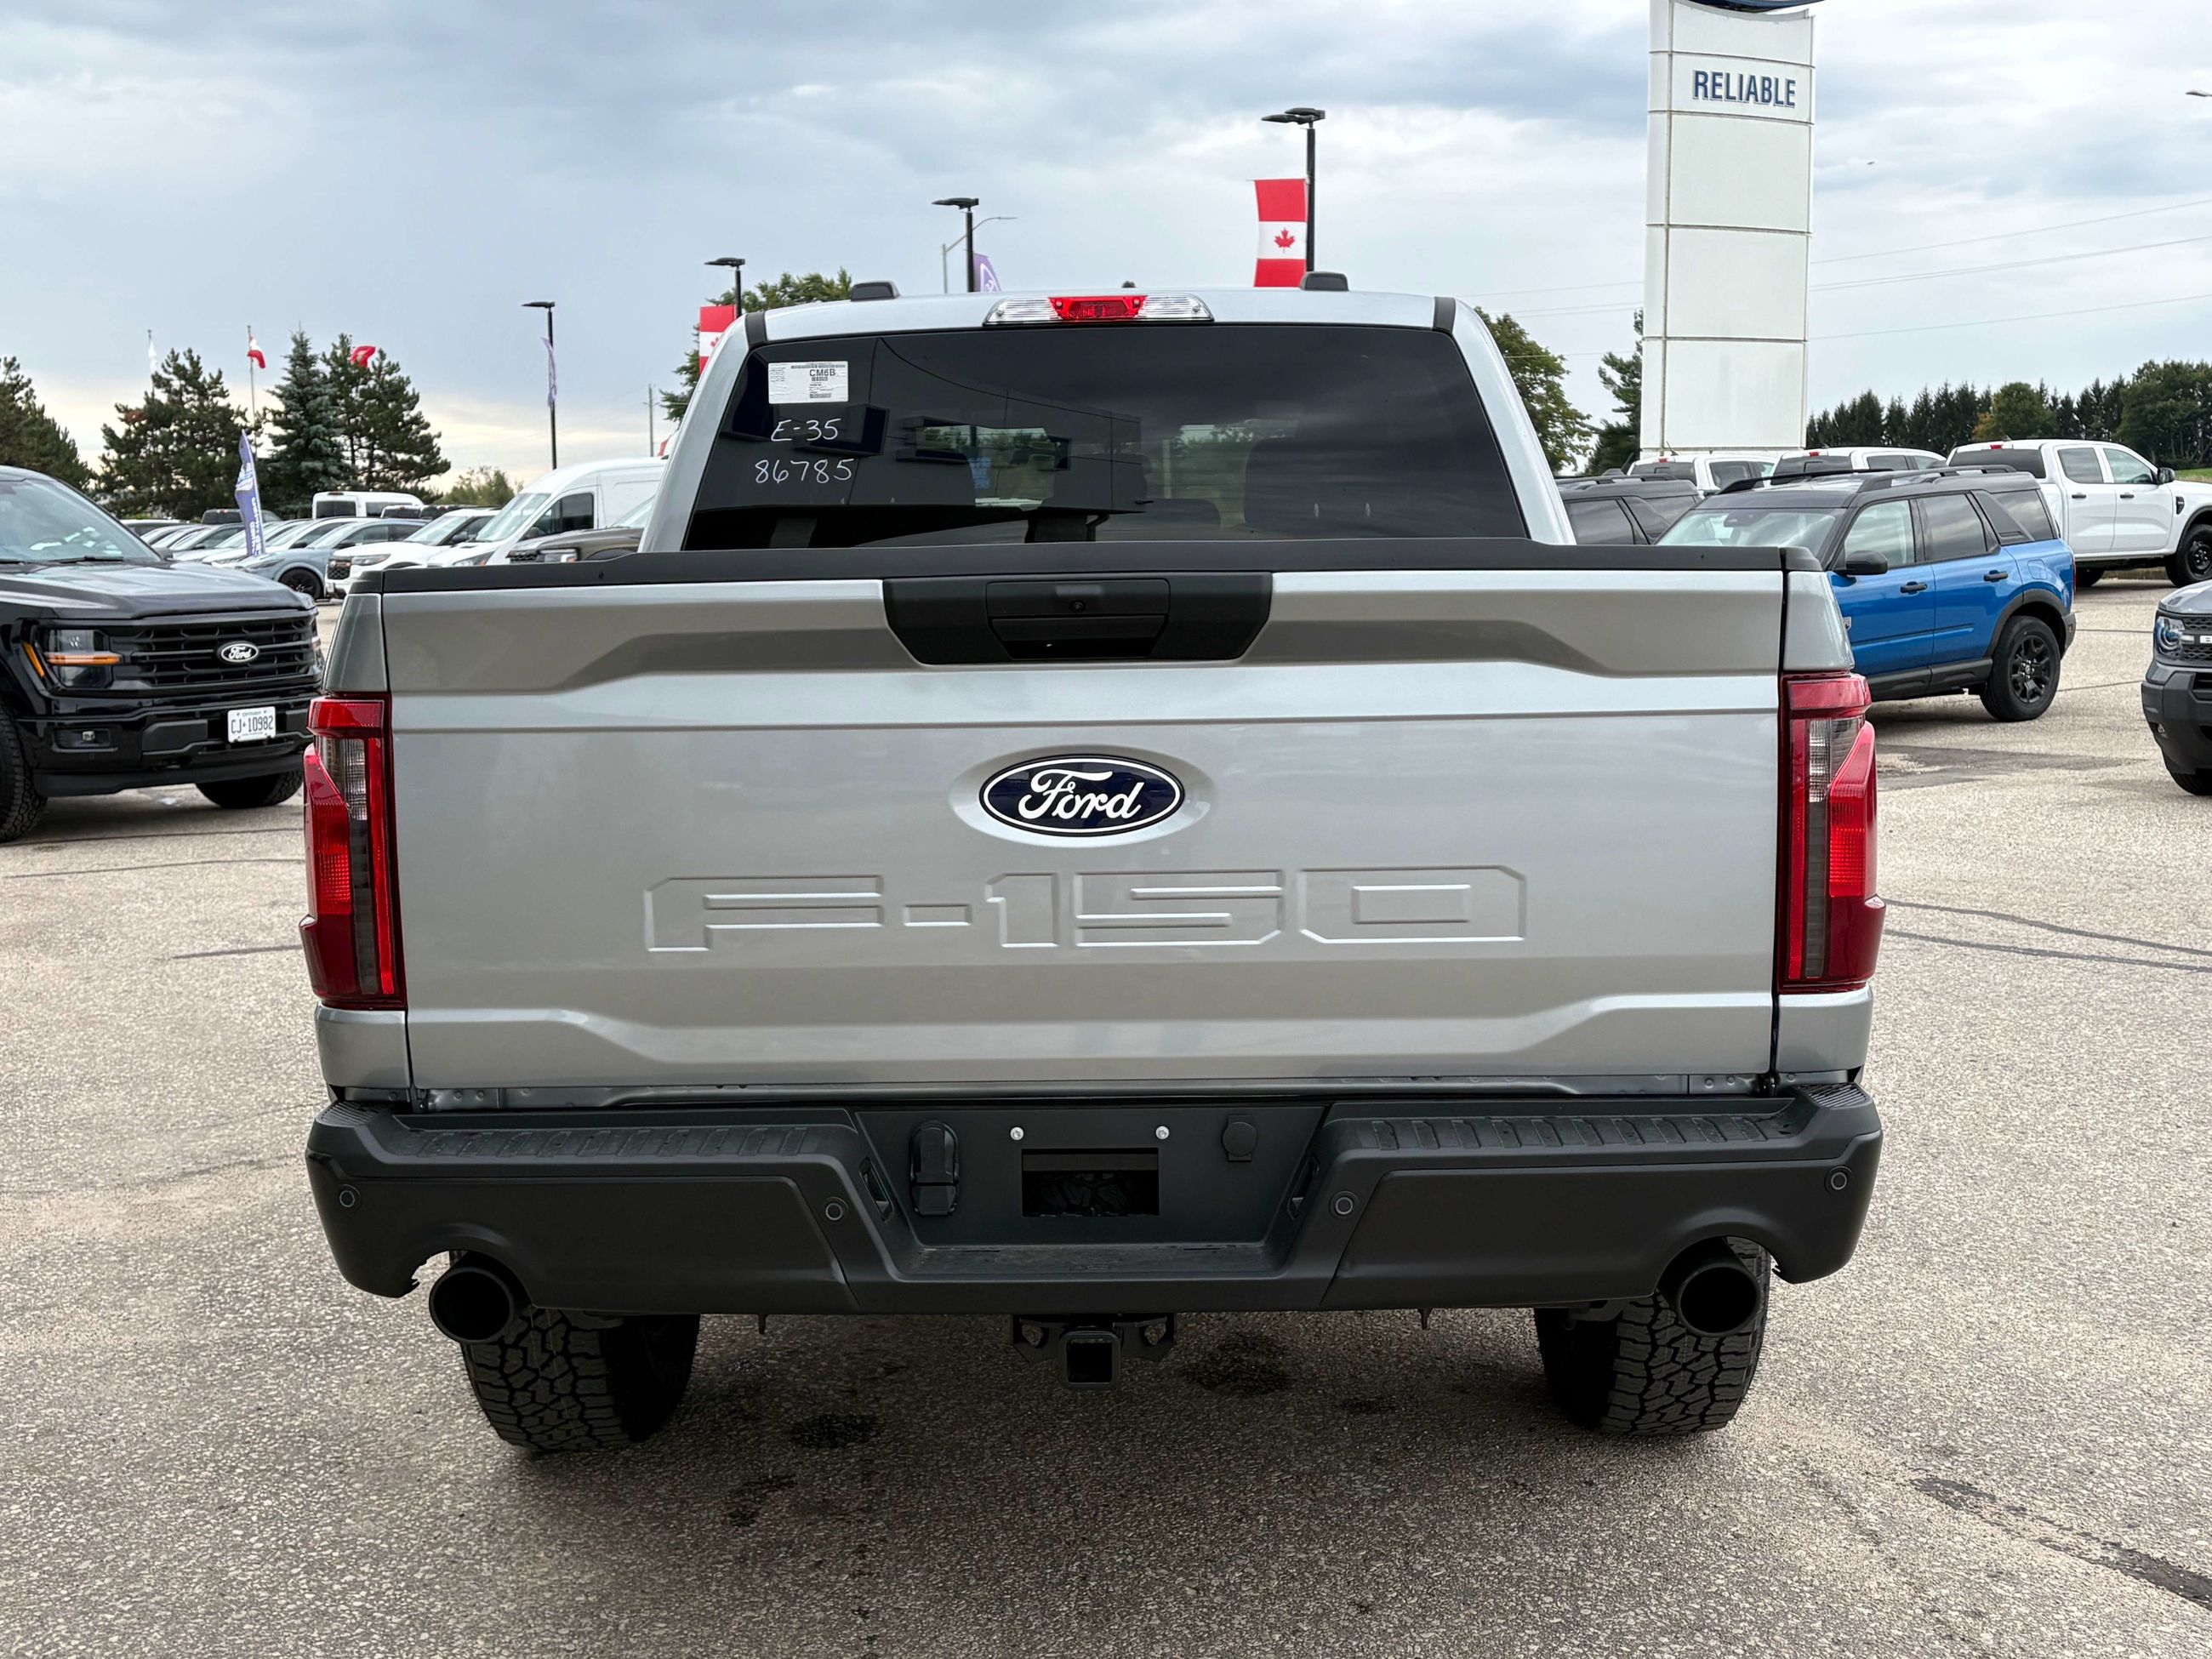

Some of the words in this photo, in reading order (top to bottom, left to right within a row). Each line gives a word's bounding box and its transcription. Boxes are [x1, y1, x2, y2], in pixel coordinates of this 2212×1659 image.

[1693, 70, 1796, 108] RELIABLE
[809, 368, 836, 377] CM6B
[771, 419, 841, 442] E-35
[755, 459, 854, 484] 86785
[229, 647, 252, 659] Ford
[1018, 768, 1145, 819] Ford
[644, 864, 1527, 953] F-150
